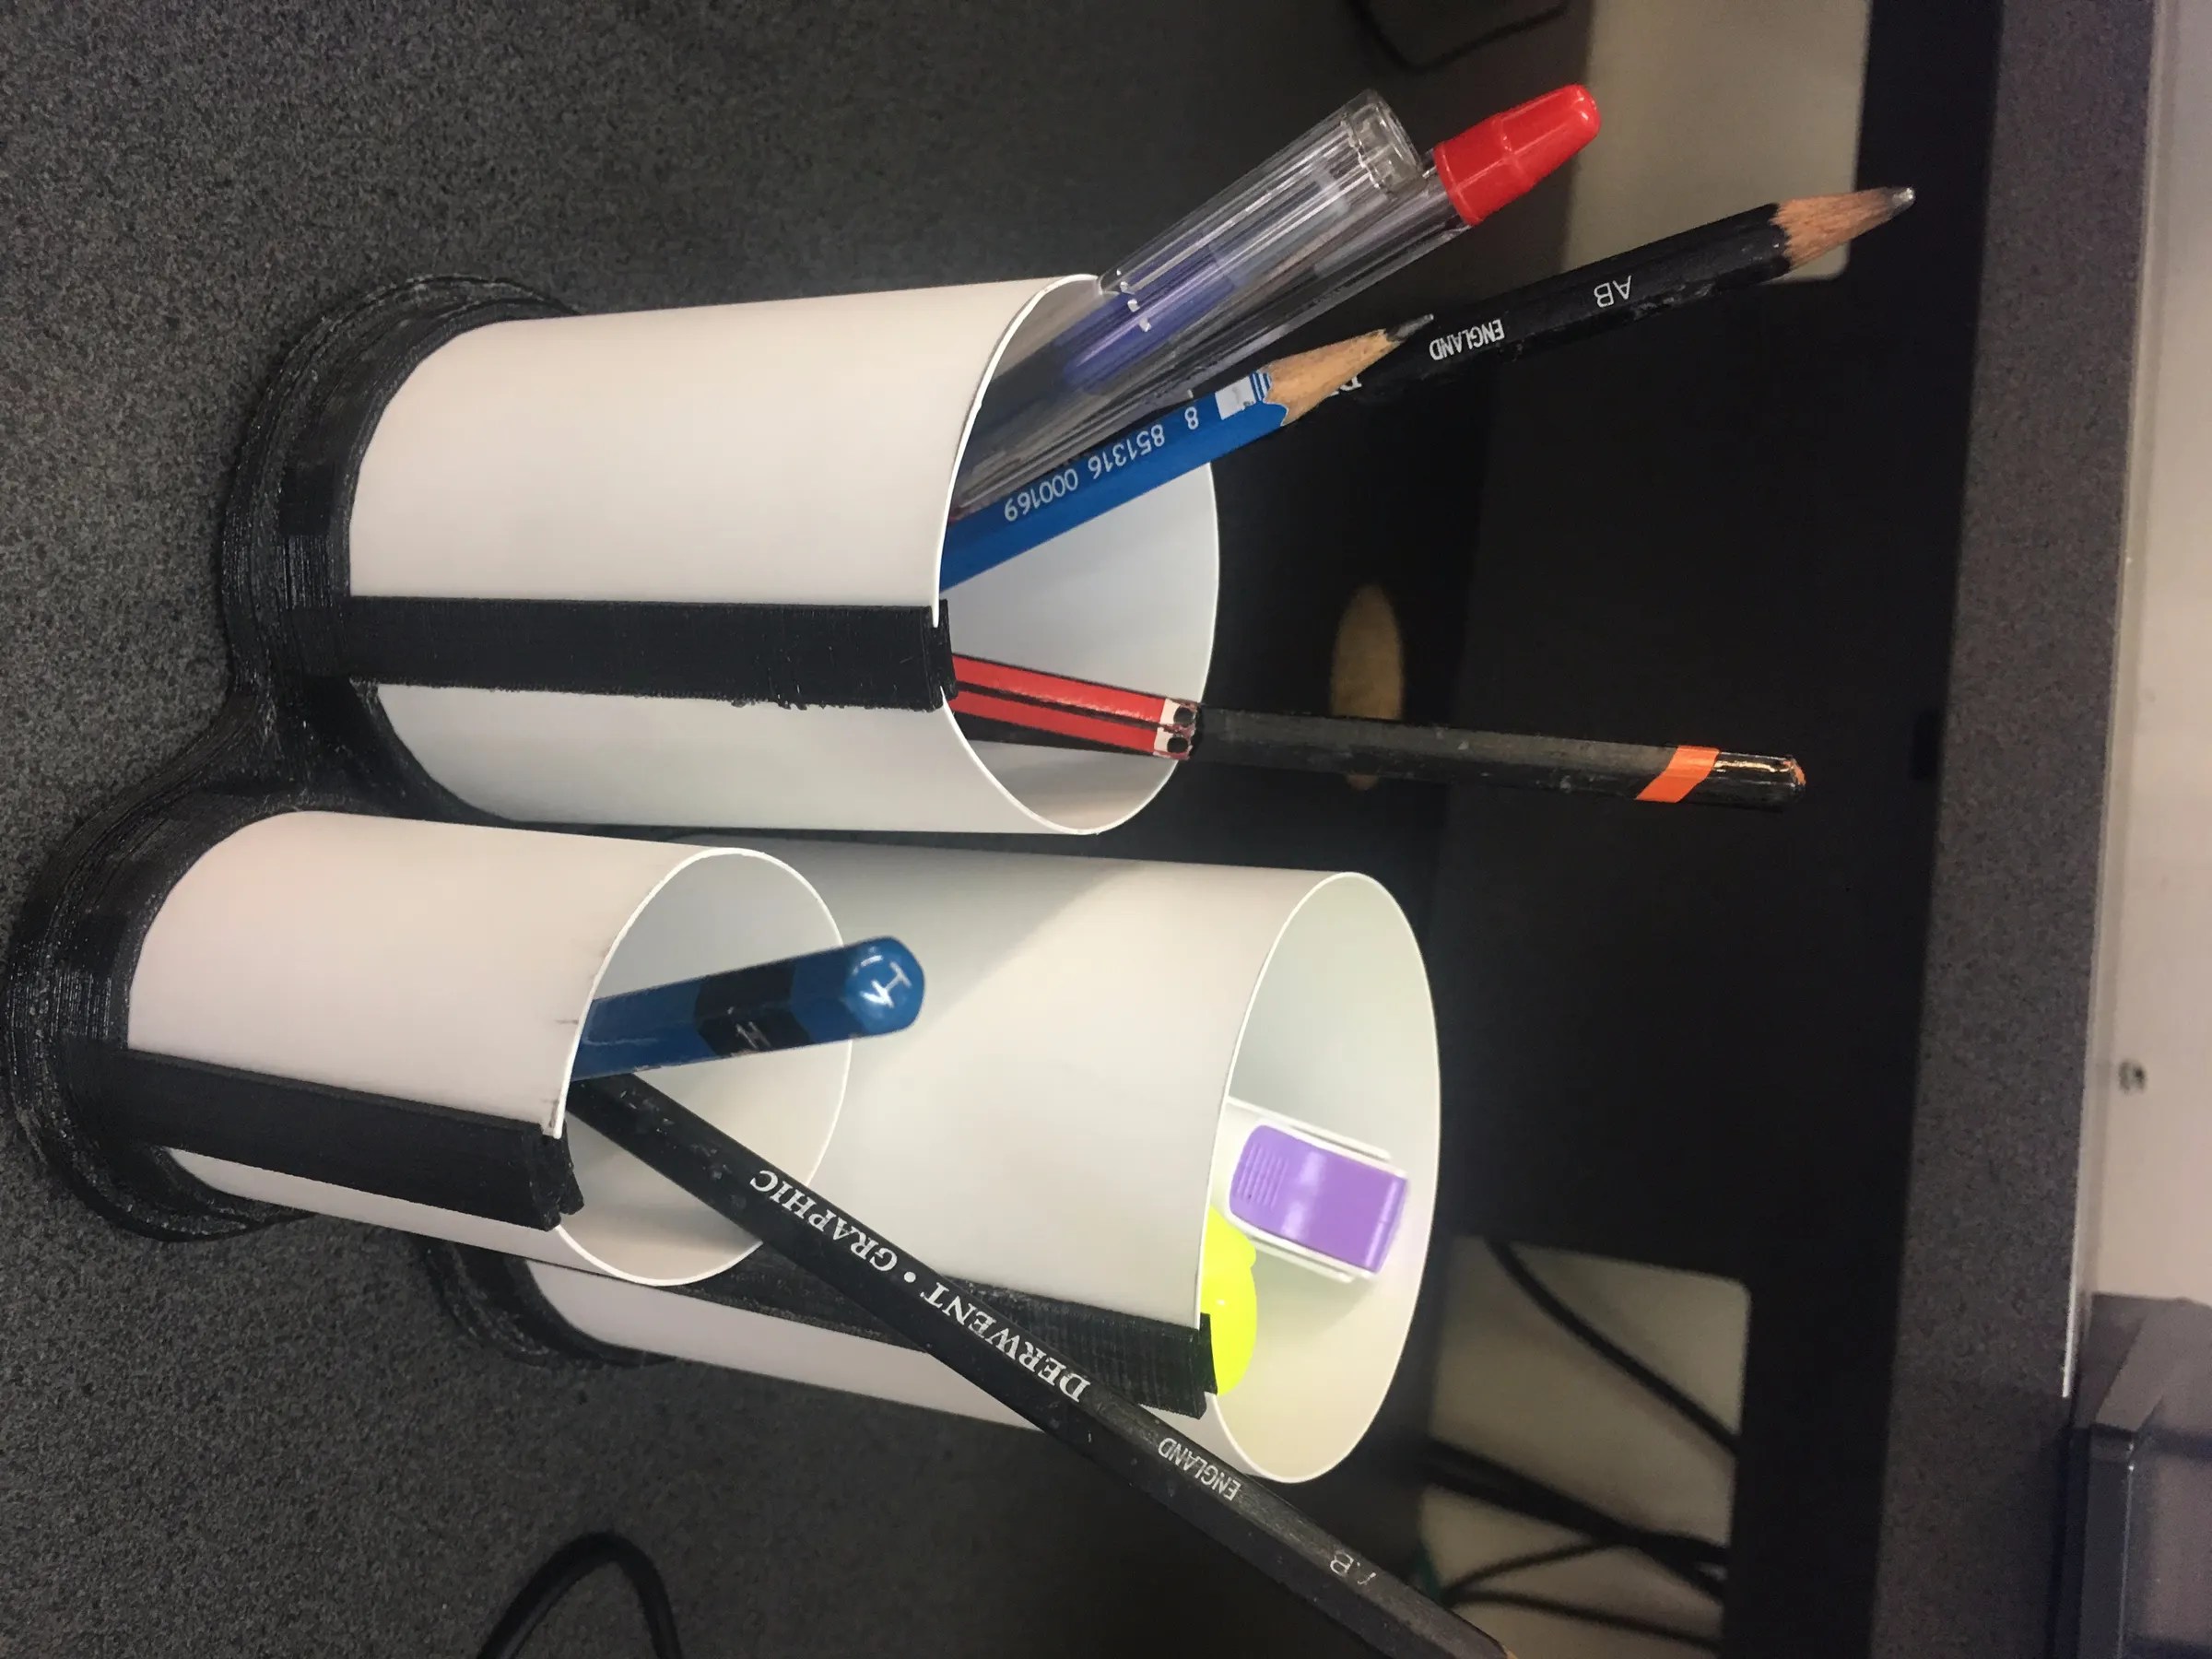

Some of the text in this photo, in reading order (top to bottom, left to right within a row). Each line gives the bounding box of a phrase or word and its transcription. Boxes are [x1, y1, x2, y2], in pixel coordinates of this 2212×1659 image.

[1429, 275, 1631, 361] AB ENGLAND
[1004, 406, 1199, 522] 8 851316 000169
[749, 1170, 898, 1272] GRAPHIC
[919, 1281, 1091, 1403] DERWENT
[1158, 1437, 1241, 1501] ENGLAND
